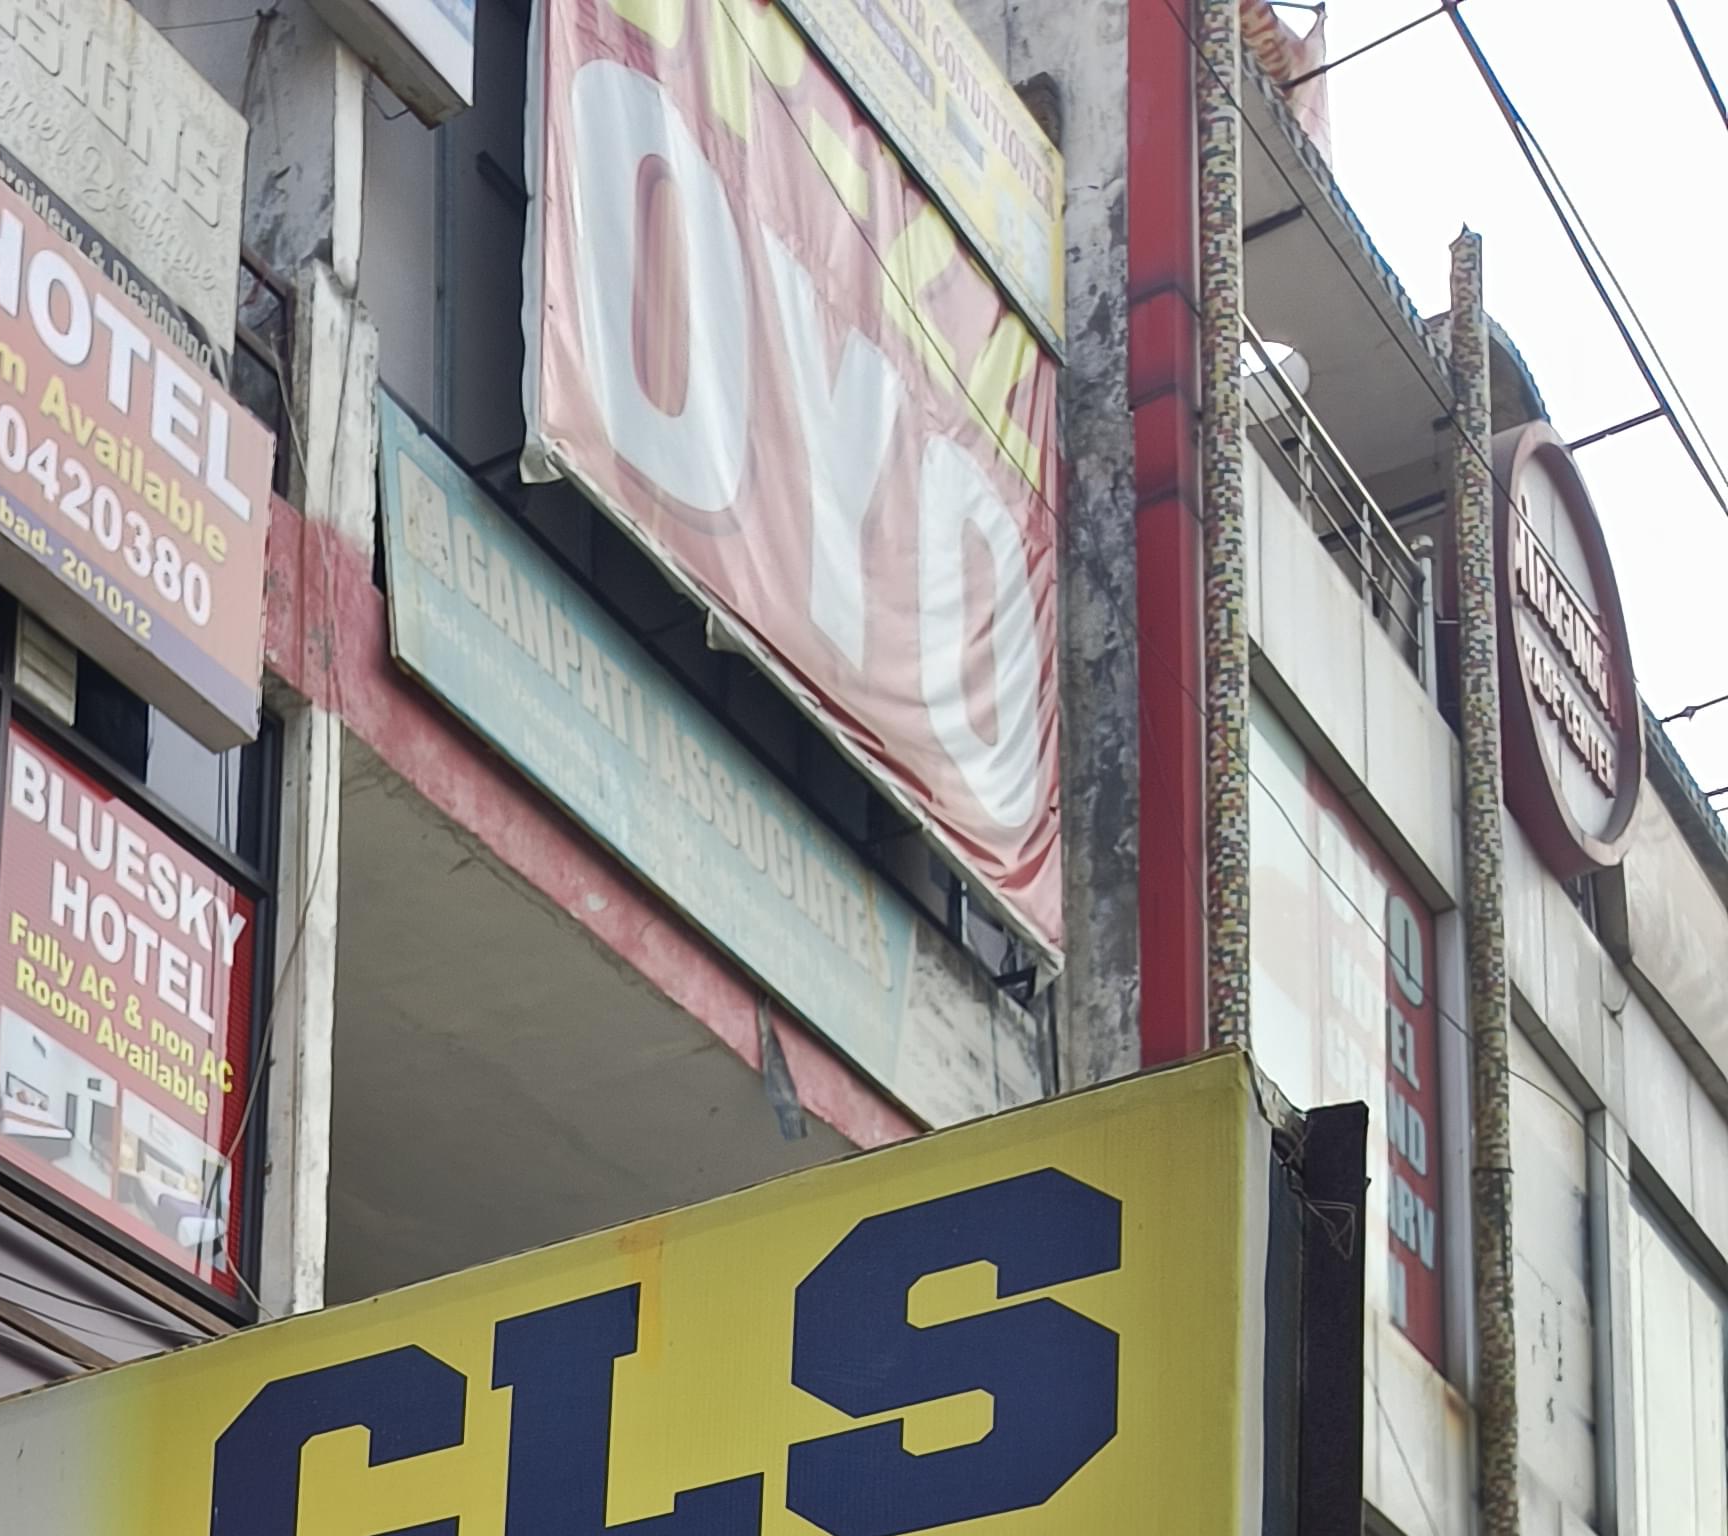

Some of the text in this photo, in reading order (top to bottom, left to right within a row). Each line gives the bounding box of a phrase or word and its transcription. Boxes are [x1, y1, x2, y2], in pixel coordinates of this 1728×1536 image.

[38, 373, 229, 563] Available
[570, 57, 1041, 828] OYO
[61, 549, 153, 641] 201012
[454, 514, 650, 767] GANPATI
[656, 708, 894, 993] ASSOCIATES
[9, 744, 248, 969] BLUESKY
[49, 857, 216, 1035] HOTEL
[8, 911, 235, 1094] Fully AC & non AC
[15, 957, 210, 1117] Room Available
